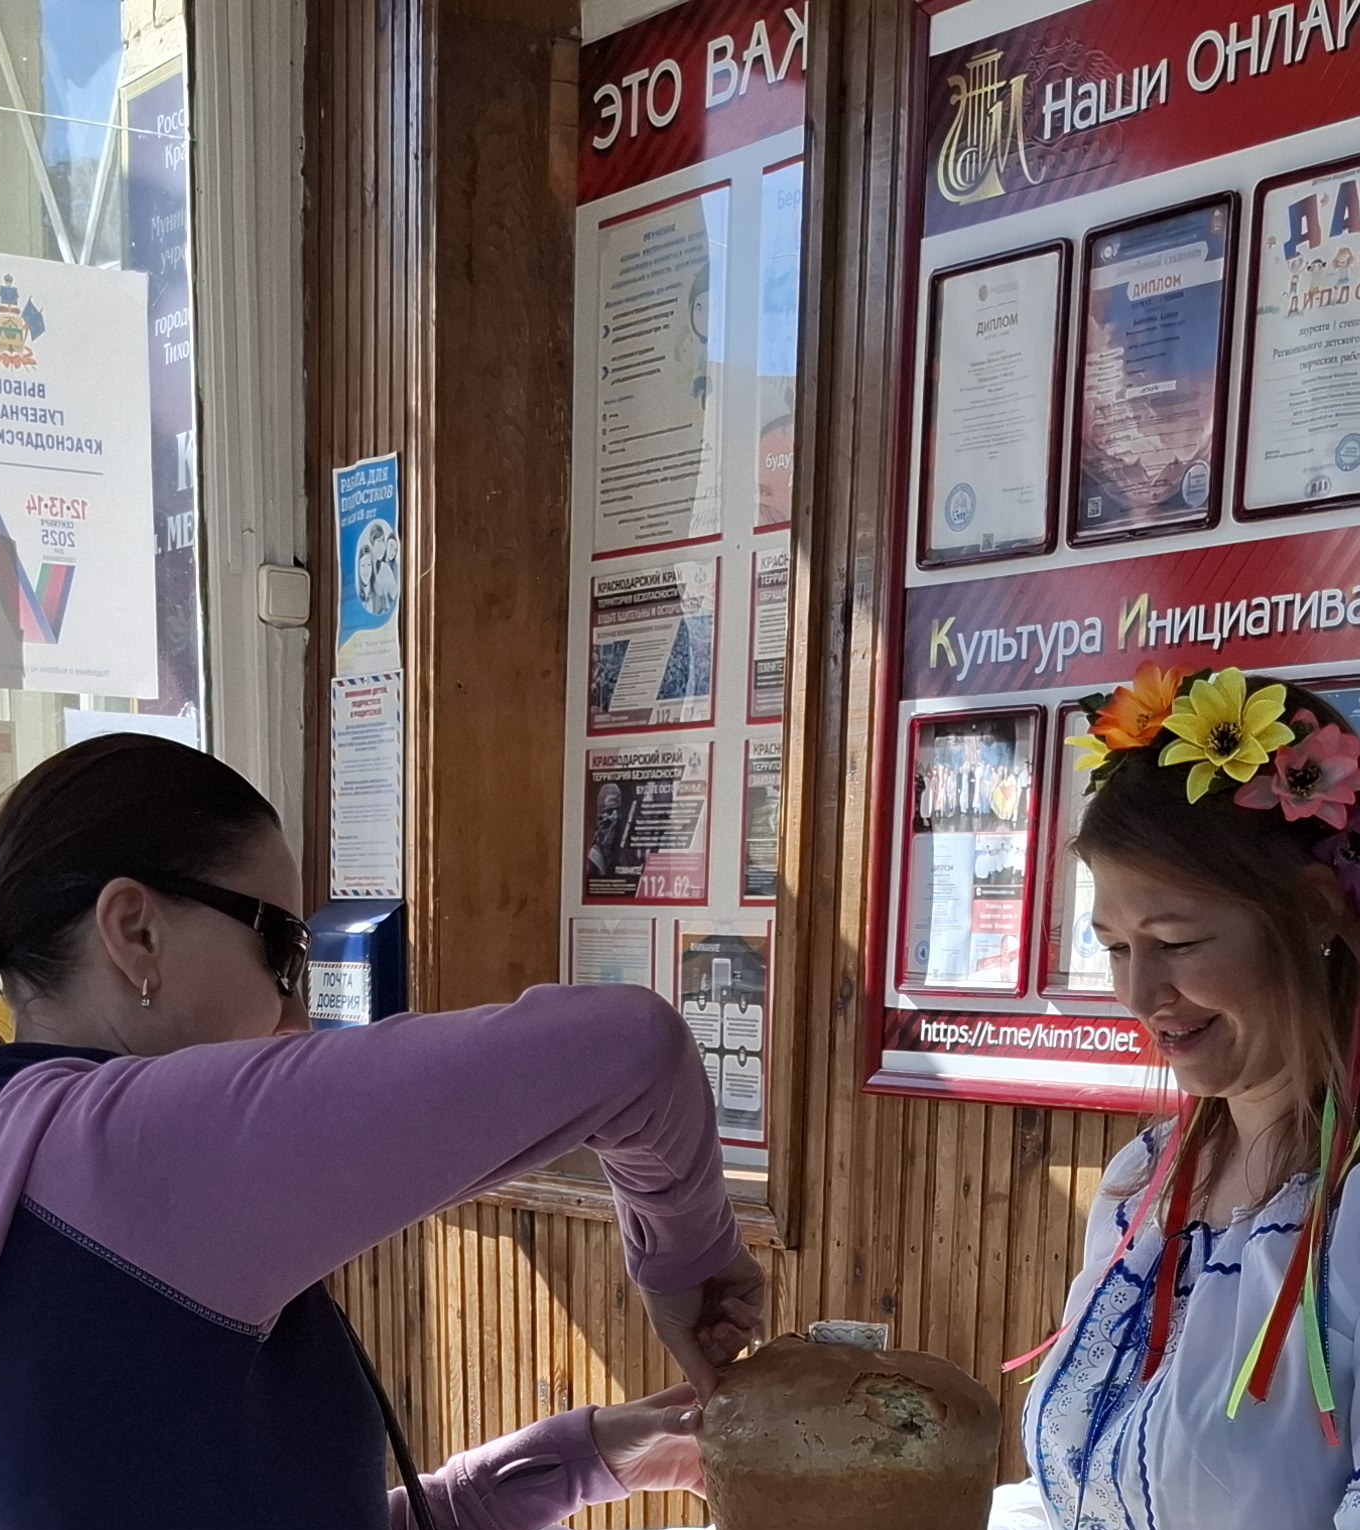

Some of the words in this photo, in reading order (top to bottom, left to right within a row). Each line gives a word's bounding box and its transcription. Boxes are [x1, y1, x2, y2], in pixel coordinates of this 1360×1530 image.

[592, 58, 682, 150] ЭТО
[1042, 57, 1169, 140] Наши
[1133, 274, 1181, 298] ДИПЛОМ
[976, 313, 1019, 337] ДИПЛОМ
[1299, 323, 1330, 337] лауреата
[1272, 340, 1322, 360] Регионального
[1324, 335, 1360, 349] детского
[1300, 356, 1338, 371] творческих
[367, 466, 389, 487] ДЛЯ
[597, 570, 660, 594] КРАСНОДАРСКИЙ
[929, 616, 1103, 681] Культура
[592, 750, 660, 767] КРАСНОДАРСКИЙ
[661, 749, 683, 764] КРАЙ
[592, 771, 631, 781] ТЕРРИТОРИЯ
[632, 769, 682, 780] БЕЗОПАСНОСТИ
[323, 972, 352, 988] ПОЧТА
[317, 993, 360, 1011] ДОВЕРИЯ
